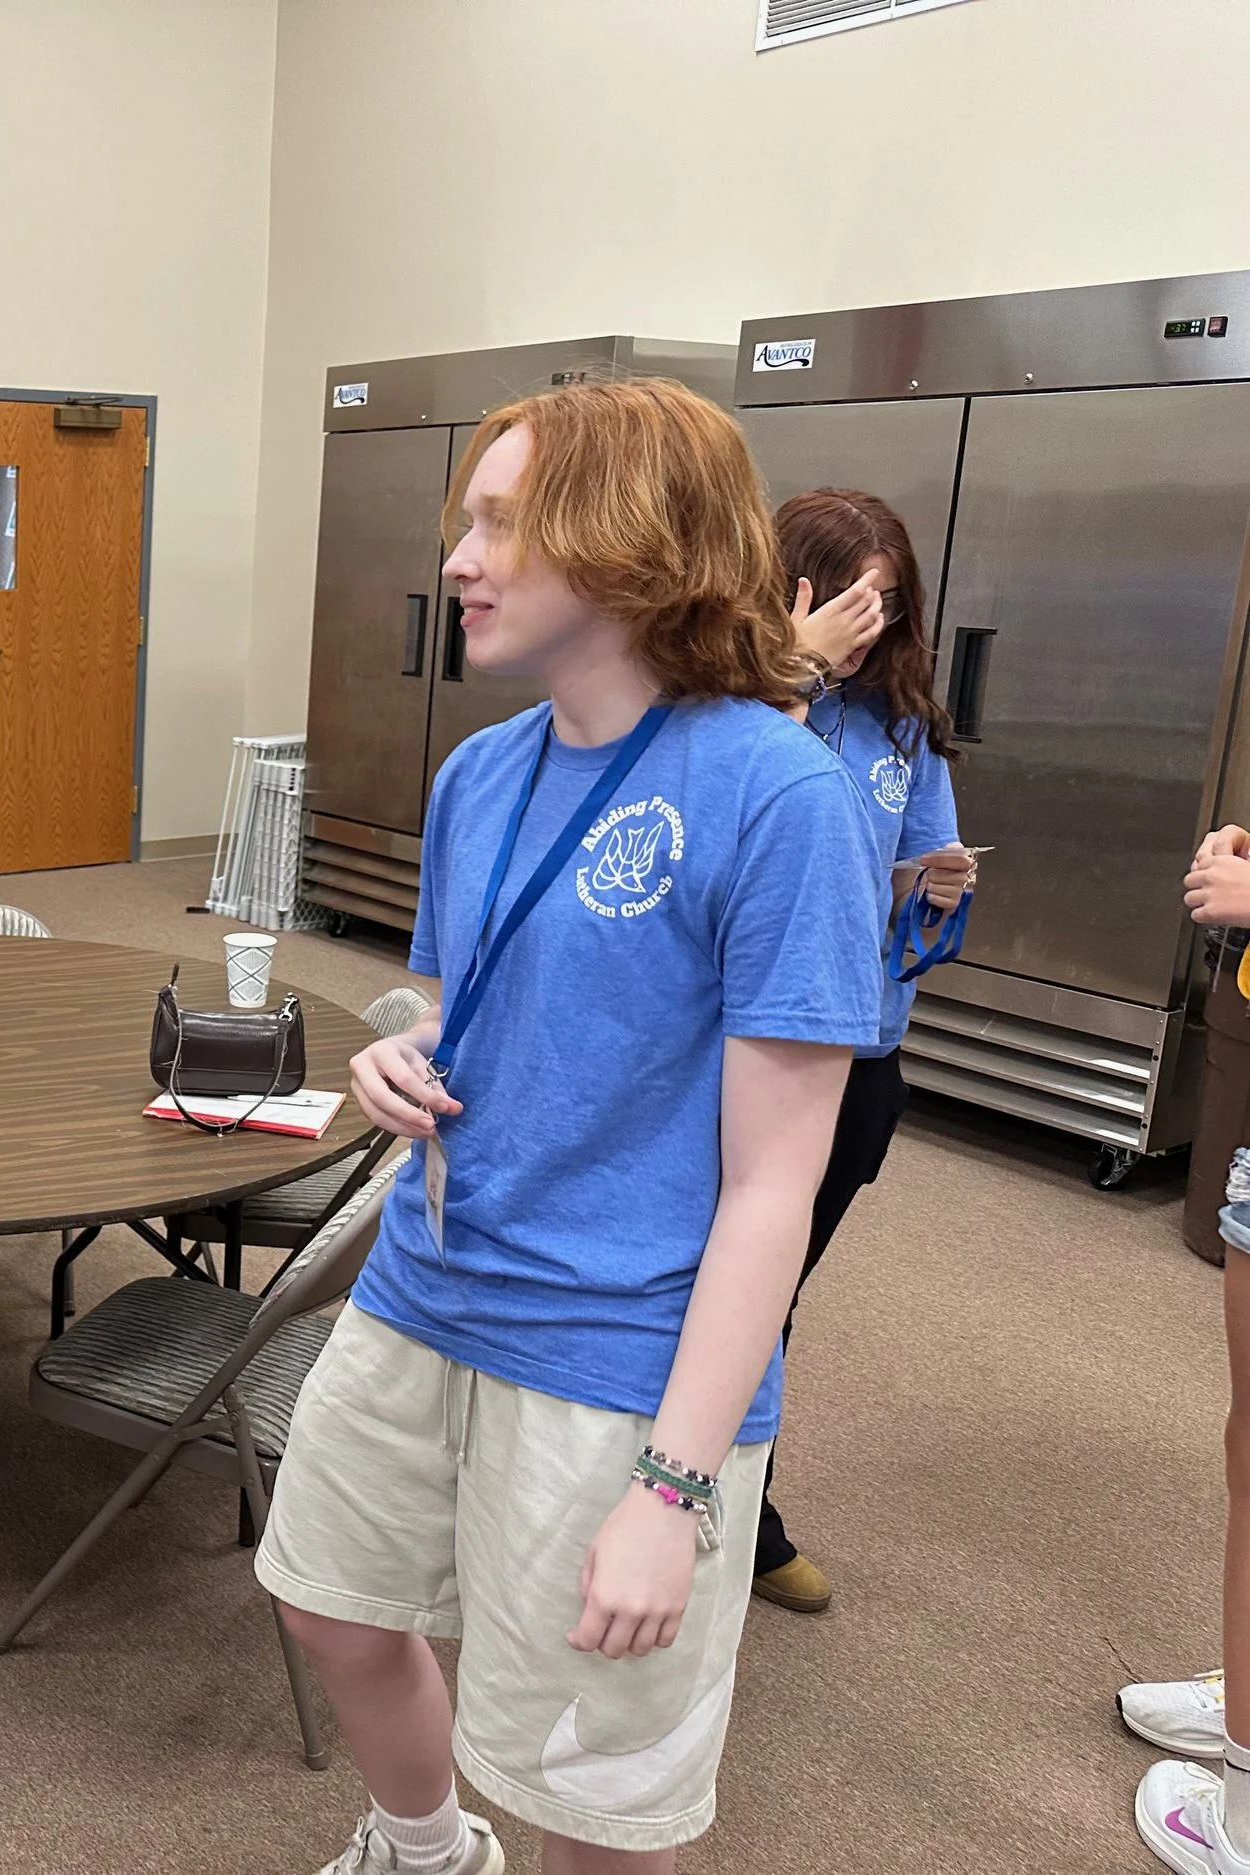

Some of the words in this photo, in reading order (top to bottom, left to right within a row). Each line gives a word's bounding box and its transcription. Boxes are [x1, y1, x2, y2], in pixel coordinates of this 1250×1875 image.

[581, 800, 648, 853] Abiding
[648, 796, 685, 861] Presence
[576, 866, 616, 918] Lutheran
[620, 875, 673, 918] Church
